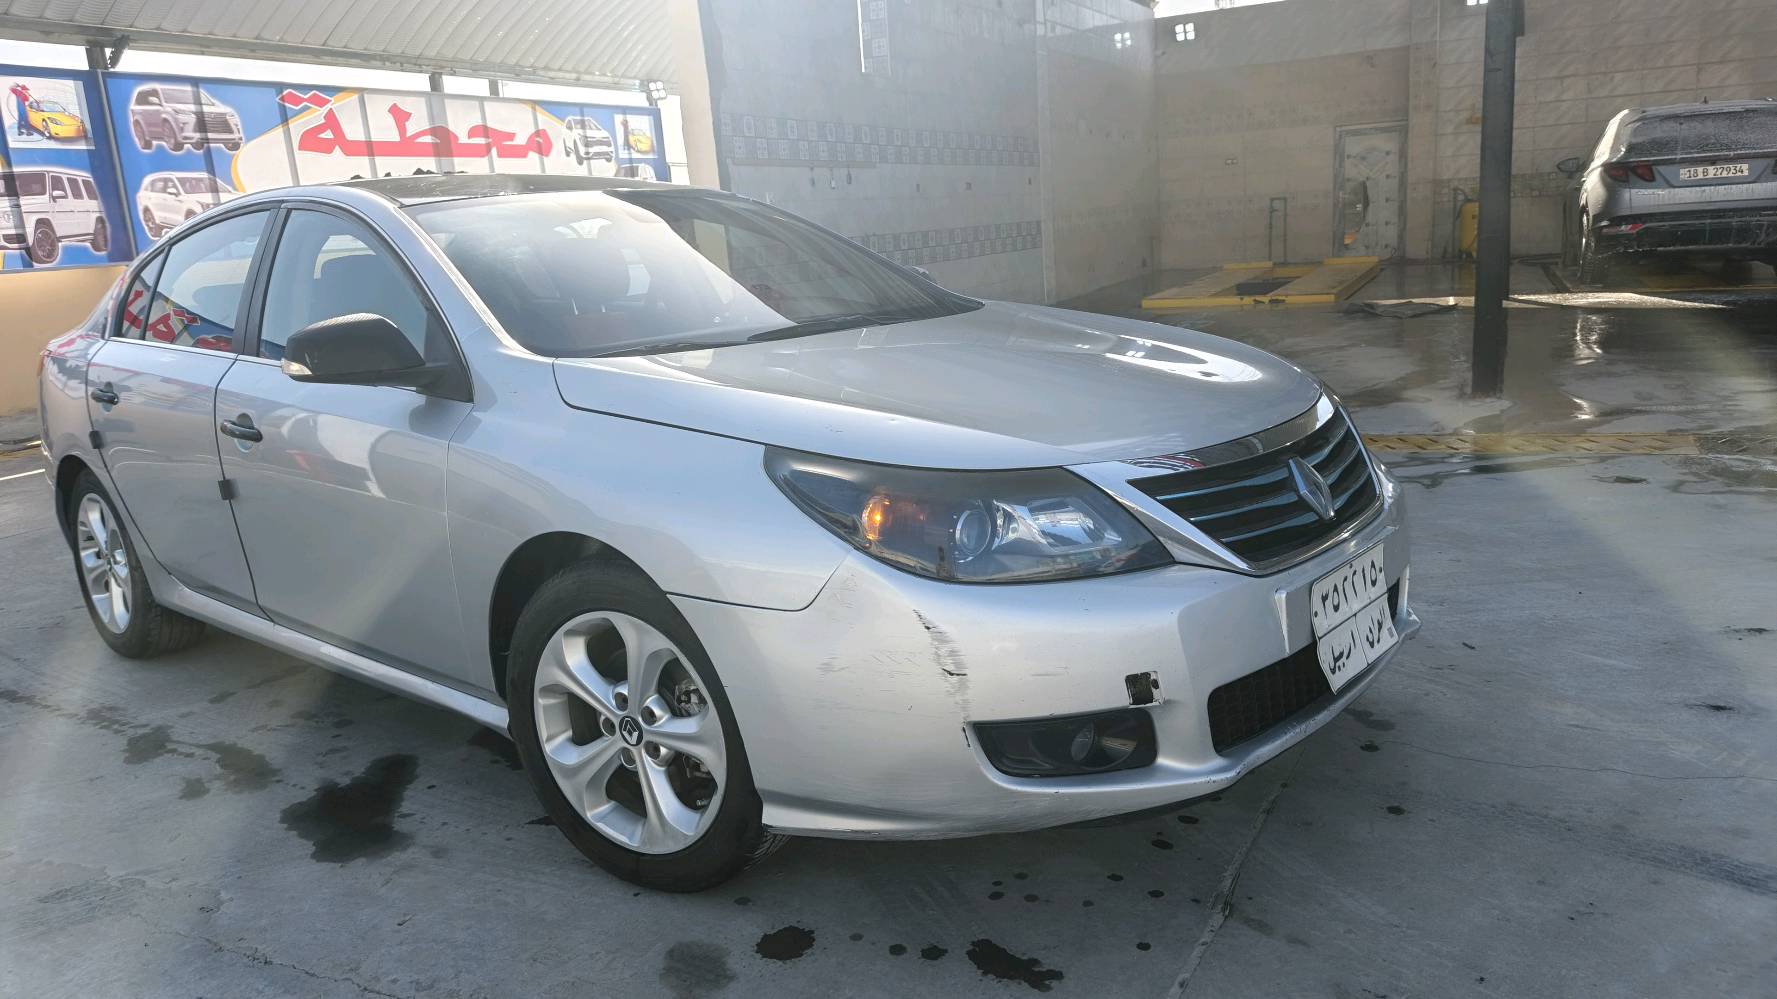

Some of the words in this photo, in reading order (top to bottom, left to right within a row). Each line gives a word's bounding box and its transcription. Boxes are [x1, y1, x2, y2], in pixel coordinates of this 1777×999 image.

[278, 89, 553, 158] محطة
[1686, 169, 1699, 179] 18
[1702, 167, 1709, 177] B
[1712, 165, 1744, 177] 27934
[1321, 559, 1378, 619] ٣٥٢٢١٥
